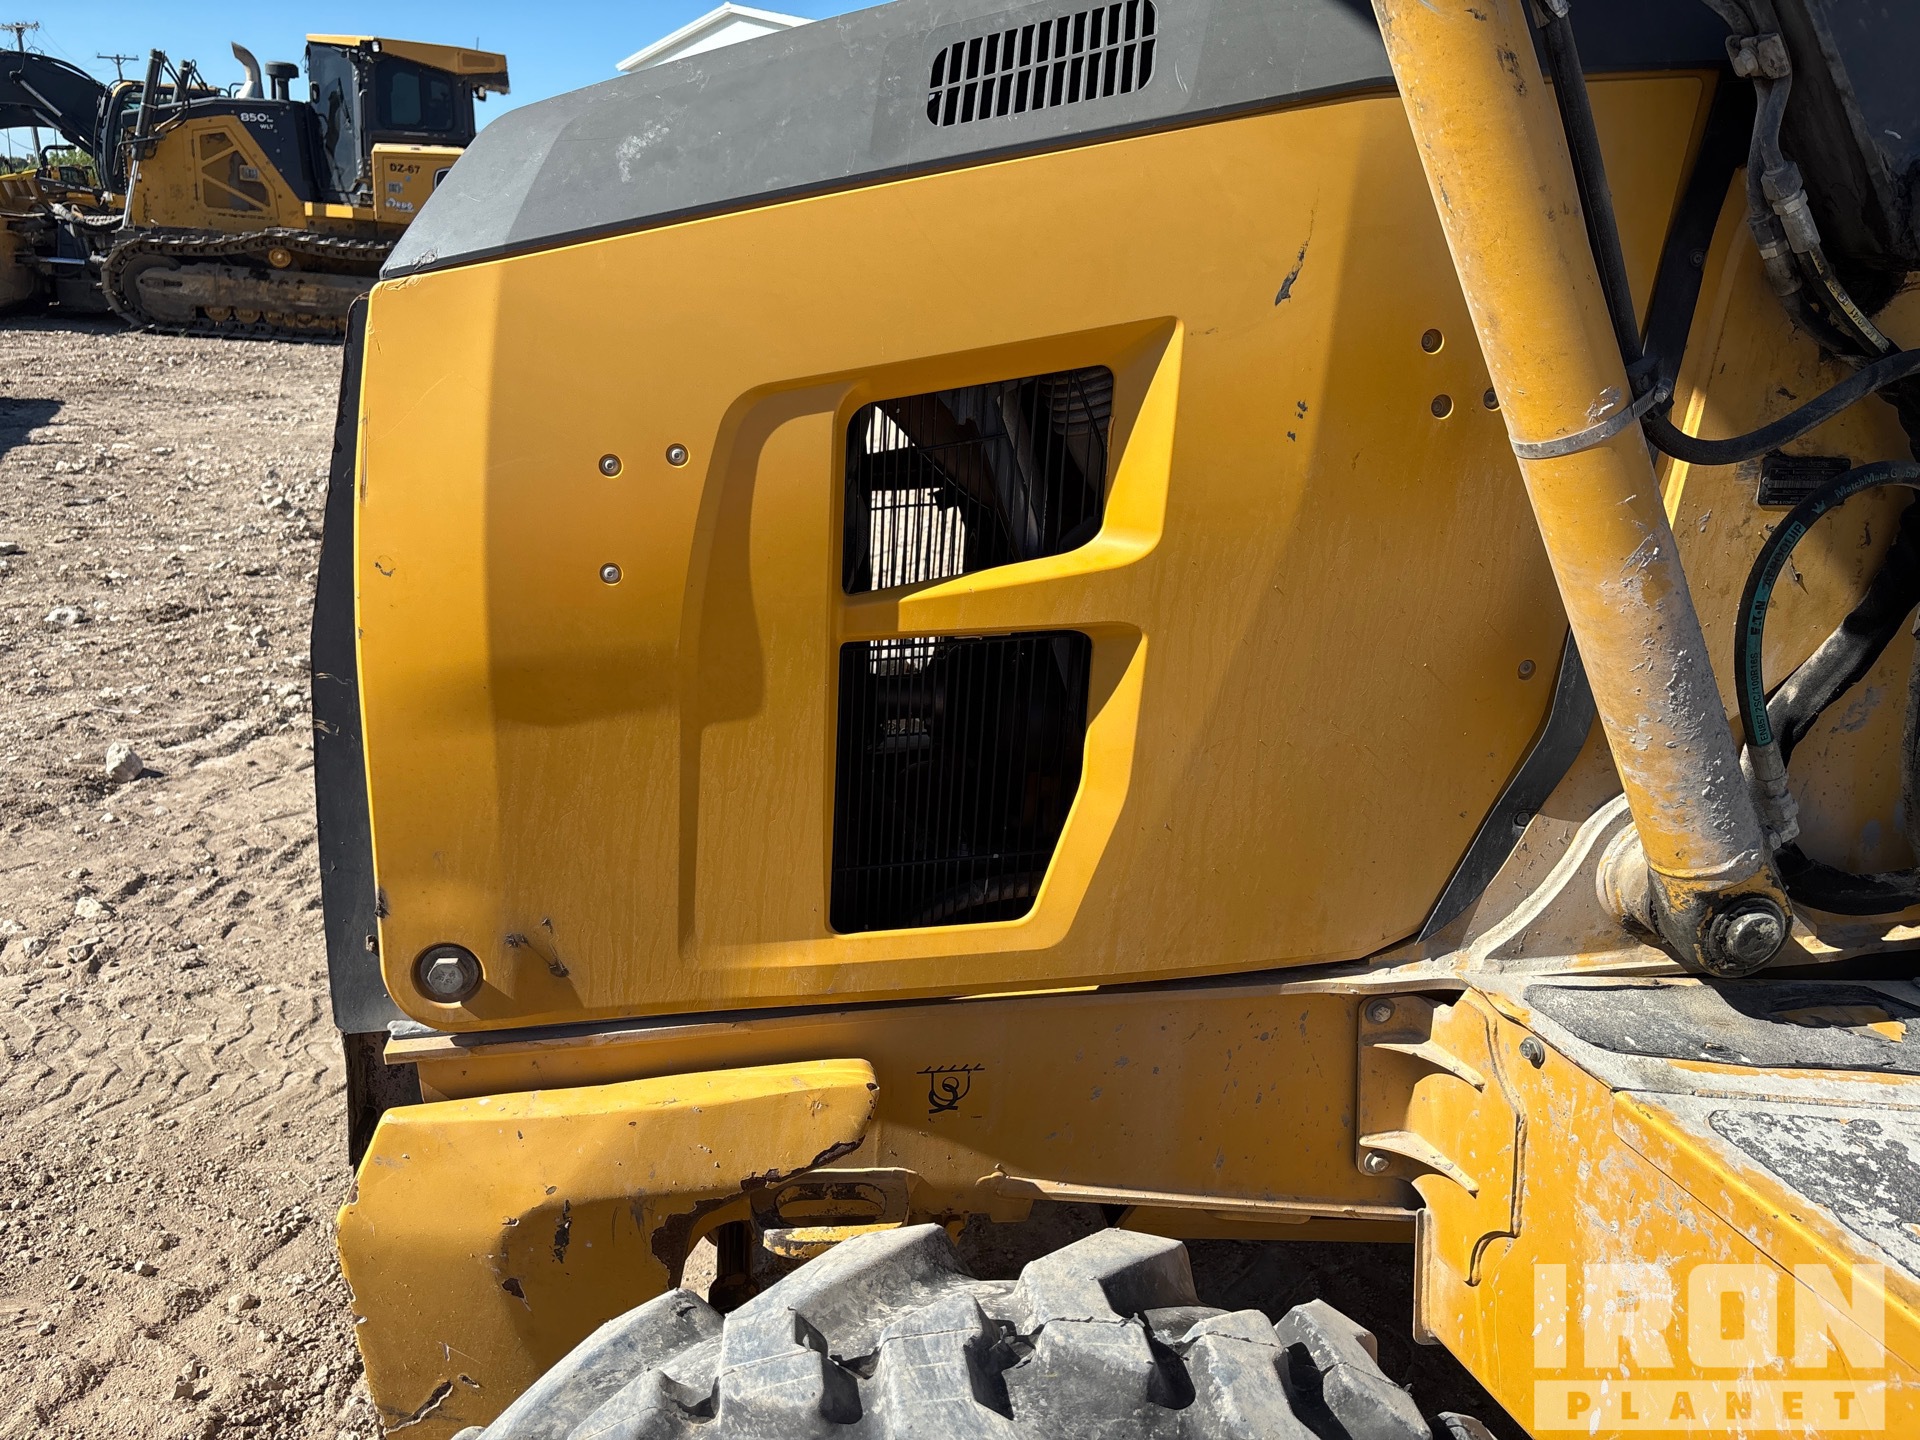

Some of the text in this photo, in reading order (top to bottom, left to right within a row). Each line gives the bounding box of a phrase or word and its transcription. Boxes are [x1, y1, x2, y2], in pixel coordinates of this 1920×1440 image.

[240, 112, 274, 123] 850L
[389, 162, 421, 174] DZ-67
[1834, 468, 1919, 498] MatchMate Gobal
[1755, 715, 1769, 742] EN857
